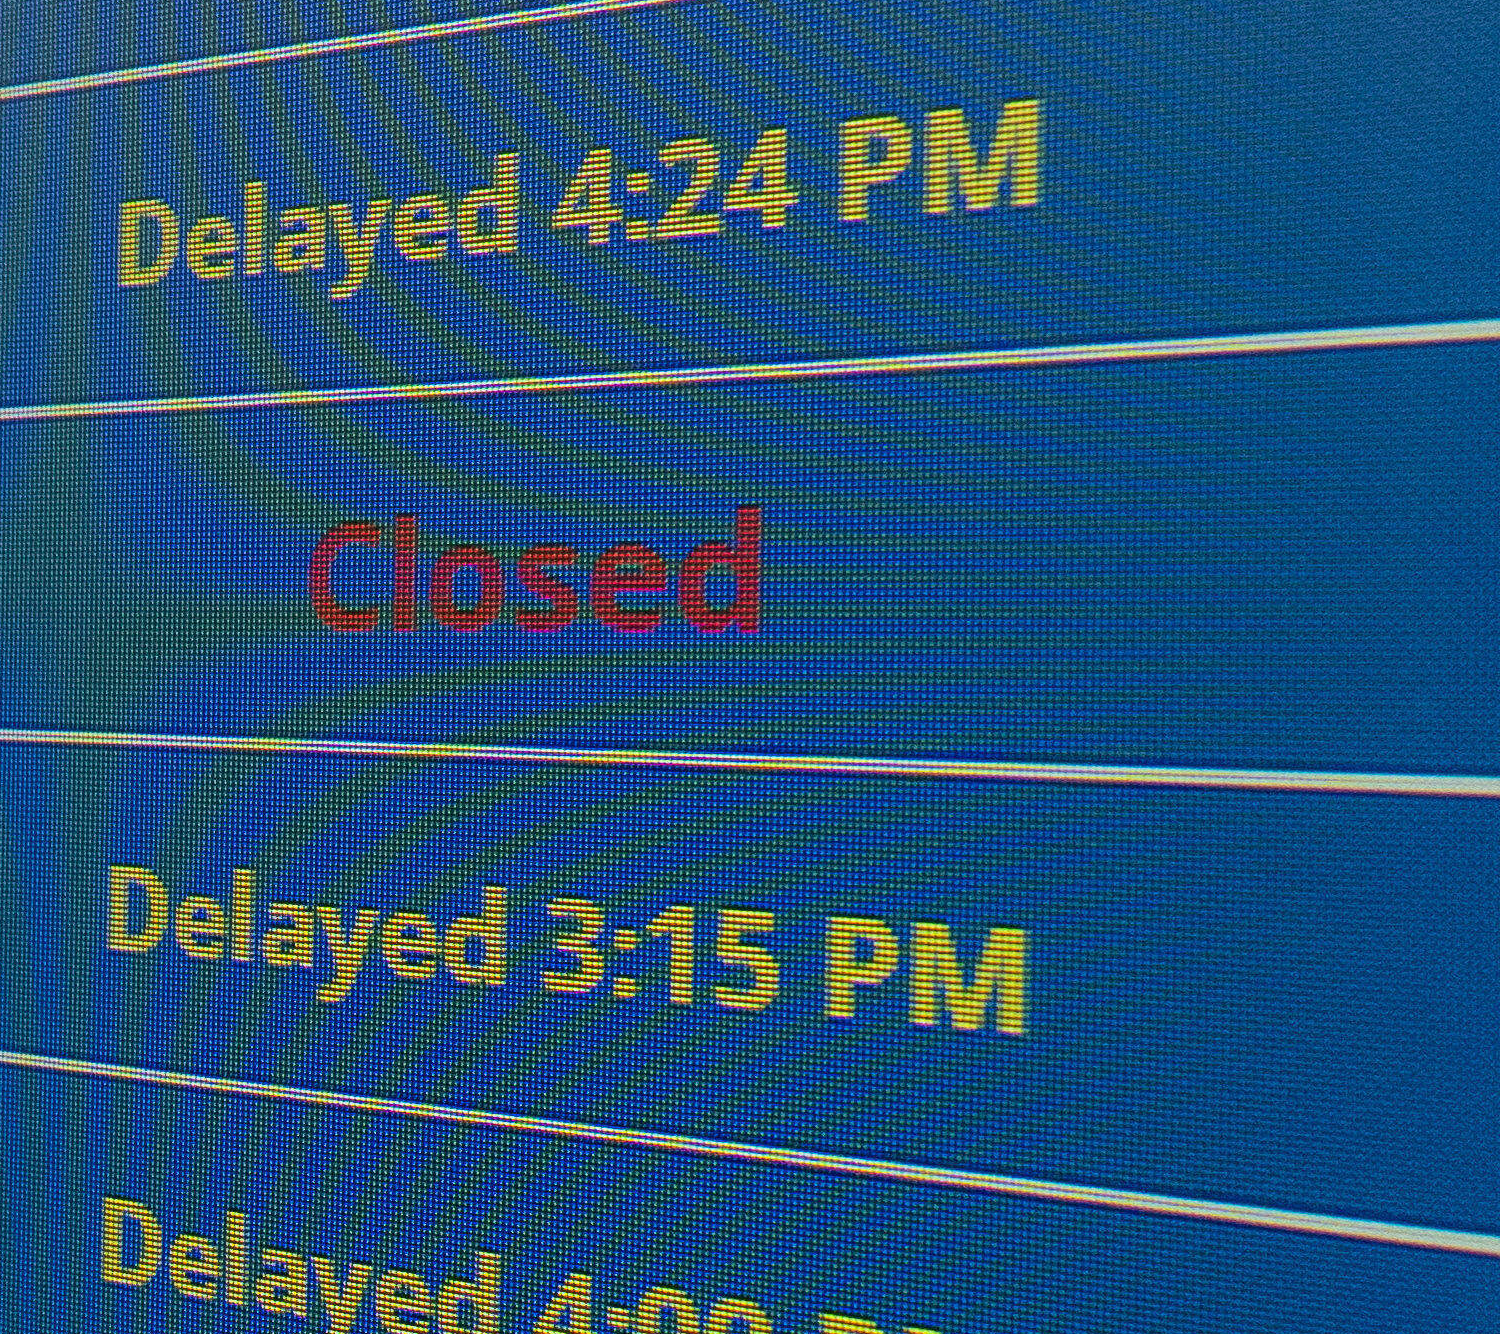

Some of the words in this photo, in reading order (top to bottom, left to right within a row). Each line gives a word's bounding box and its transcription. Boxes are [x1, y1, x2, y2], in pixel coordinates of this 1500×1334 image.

[118, 152, 520, 301] Delayed
[551, 128, 799, 246] 4:24
[837, 98, 1043, 222] PM
[307, 507, 764, 635] Closed
[106, 864, 508, 1002] Delayed
[541, 896, 780, 1011] 3:15
[825, 915, 1031, 1037] PM
